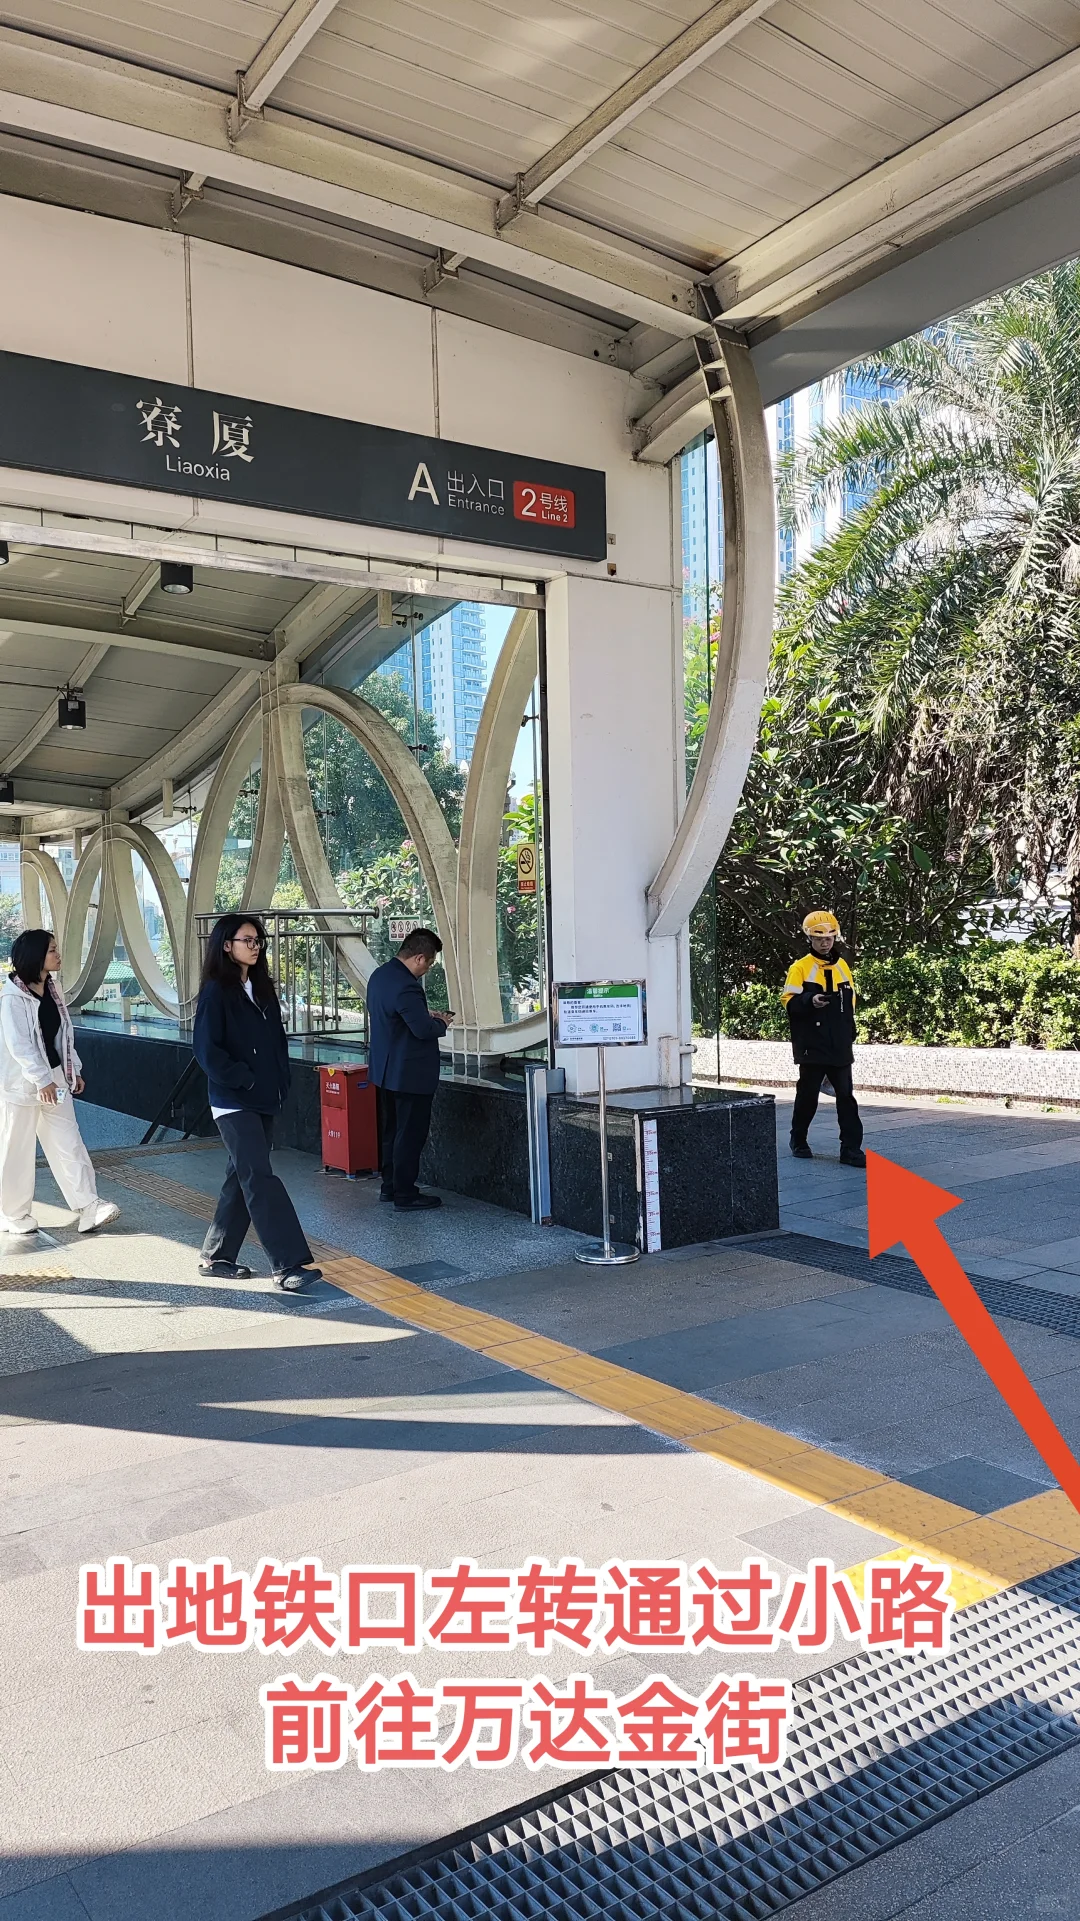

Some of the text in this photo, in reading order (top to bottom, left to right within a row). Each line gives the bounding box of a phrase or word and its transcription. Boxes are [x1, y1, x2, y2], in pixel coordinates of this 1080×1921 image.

[136, 397, 254, 463] 寮厦
[166, 455, 231, 481] Liaoxia
[407, 462, 440, 506] A
[447, 470, 504, 500] 出入口
[448, 494, 505, 516] Entrance
[541, 510, 568, 523] Line 2
